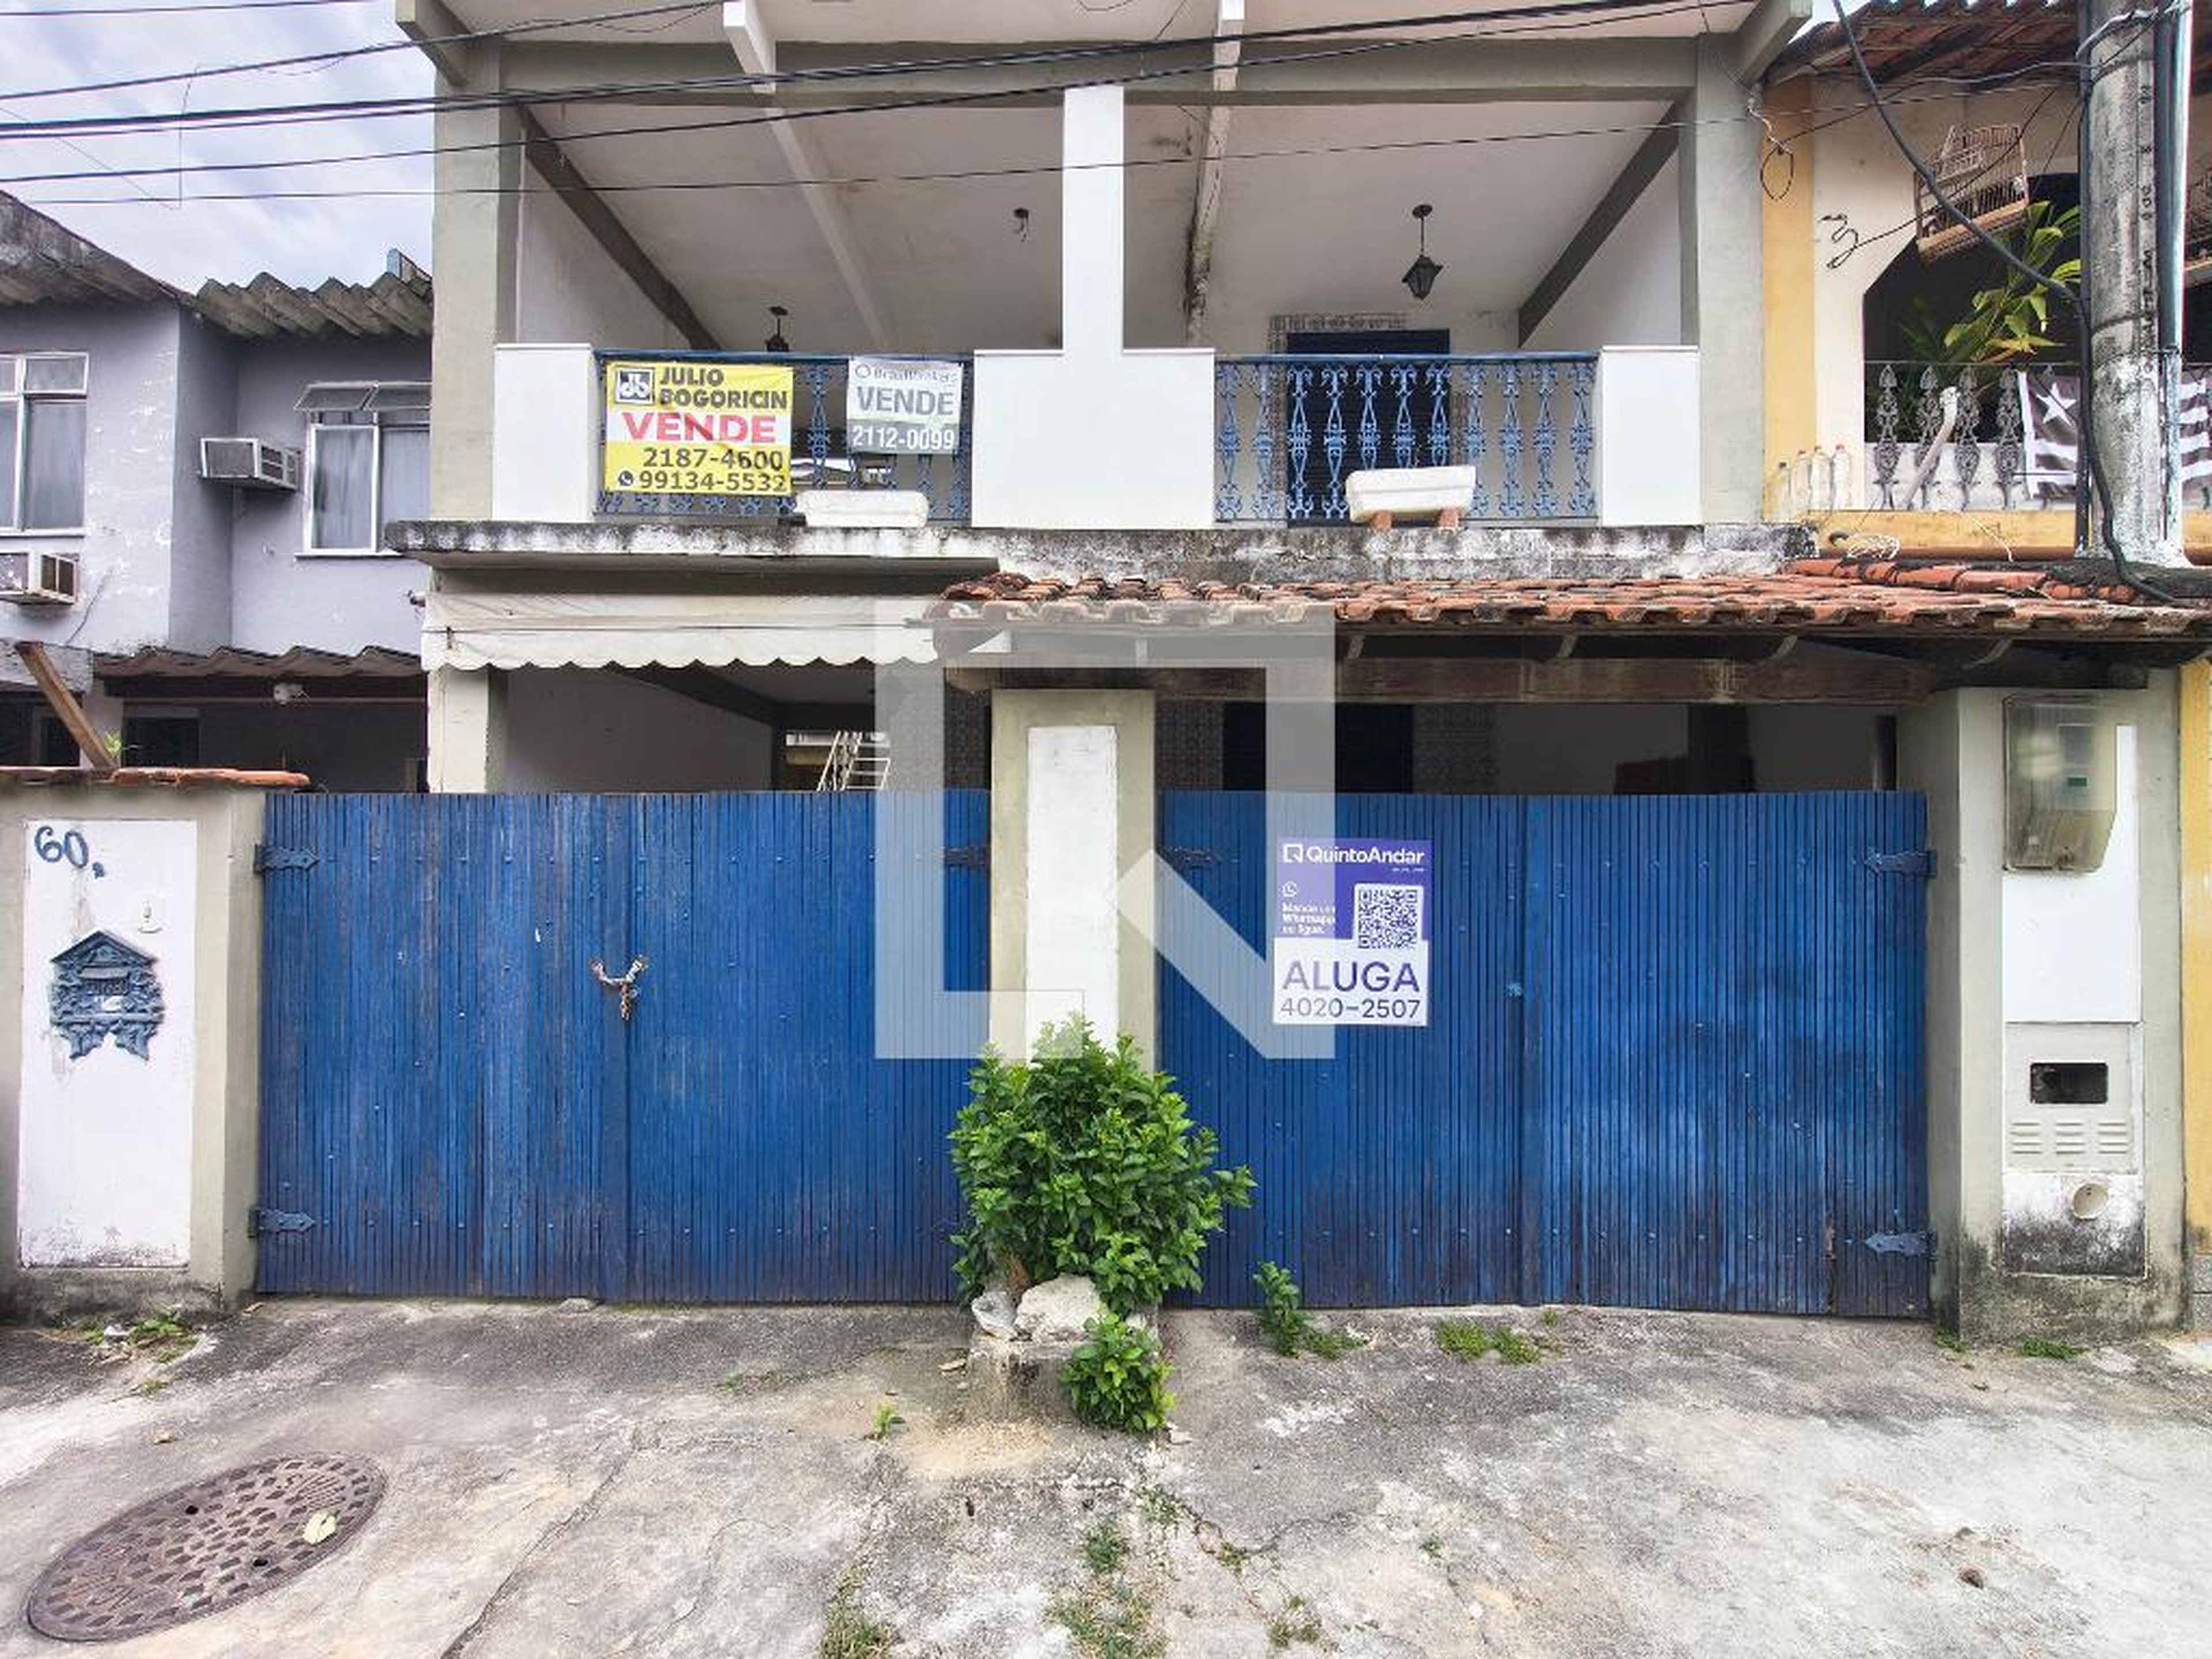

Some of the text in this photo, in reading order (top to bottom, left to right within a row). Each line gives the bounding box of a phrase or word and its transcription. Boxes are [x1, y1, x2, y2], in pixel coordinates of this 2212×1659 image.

[660, 367, 724, 387] JULIO
[660, 388, 787, 409] BOGORICIN
[857, 387, 953, 415] VENDE
[622, 412, 777, 443] VENDE
[853, 425, 955, 450] 2112-0099
[643, 448, 783, 471] 2187-4600
[639, 470, 787, 492] 99134-5532
[1306, 845, 1425, 864] QuintoAndar
[1282, 960, 1420, 993] ALUGA
[1281, 997, 1421, 1019] 4020-2507
